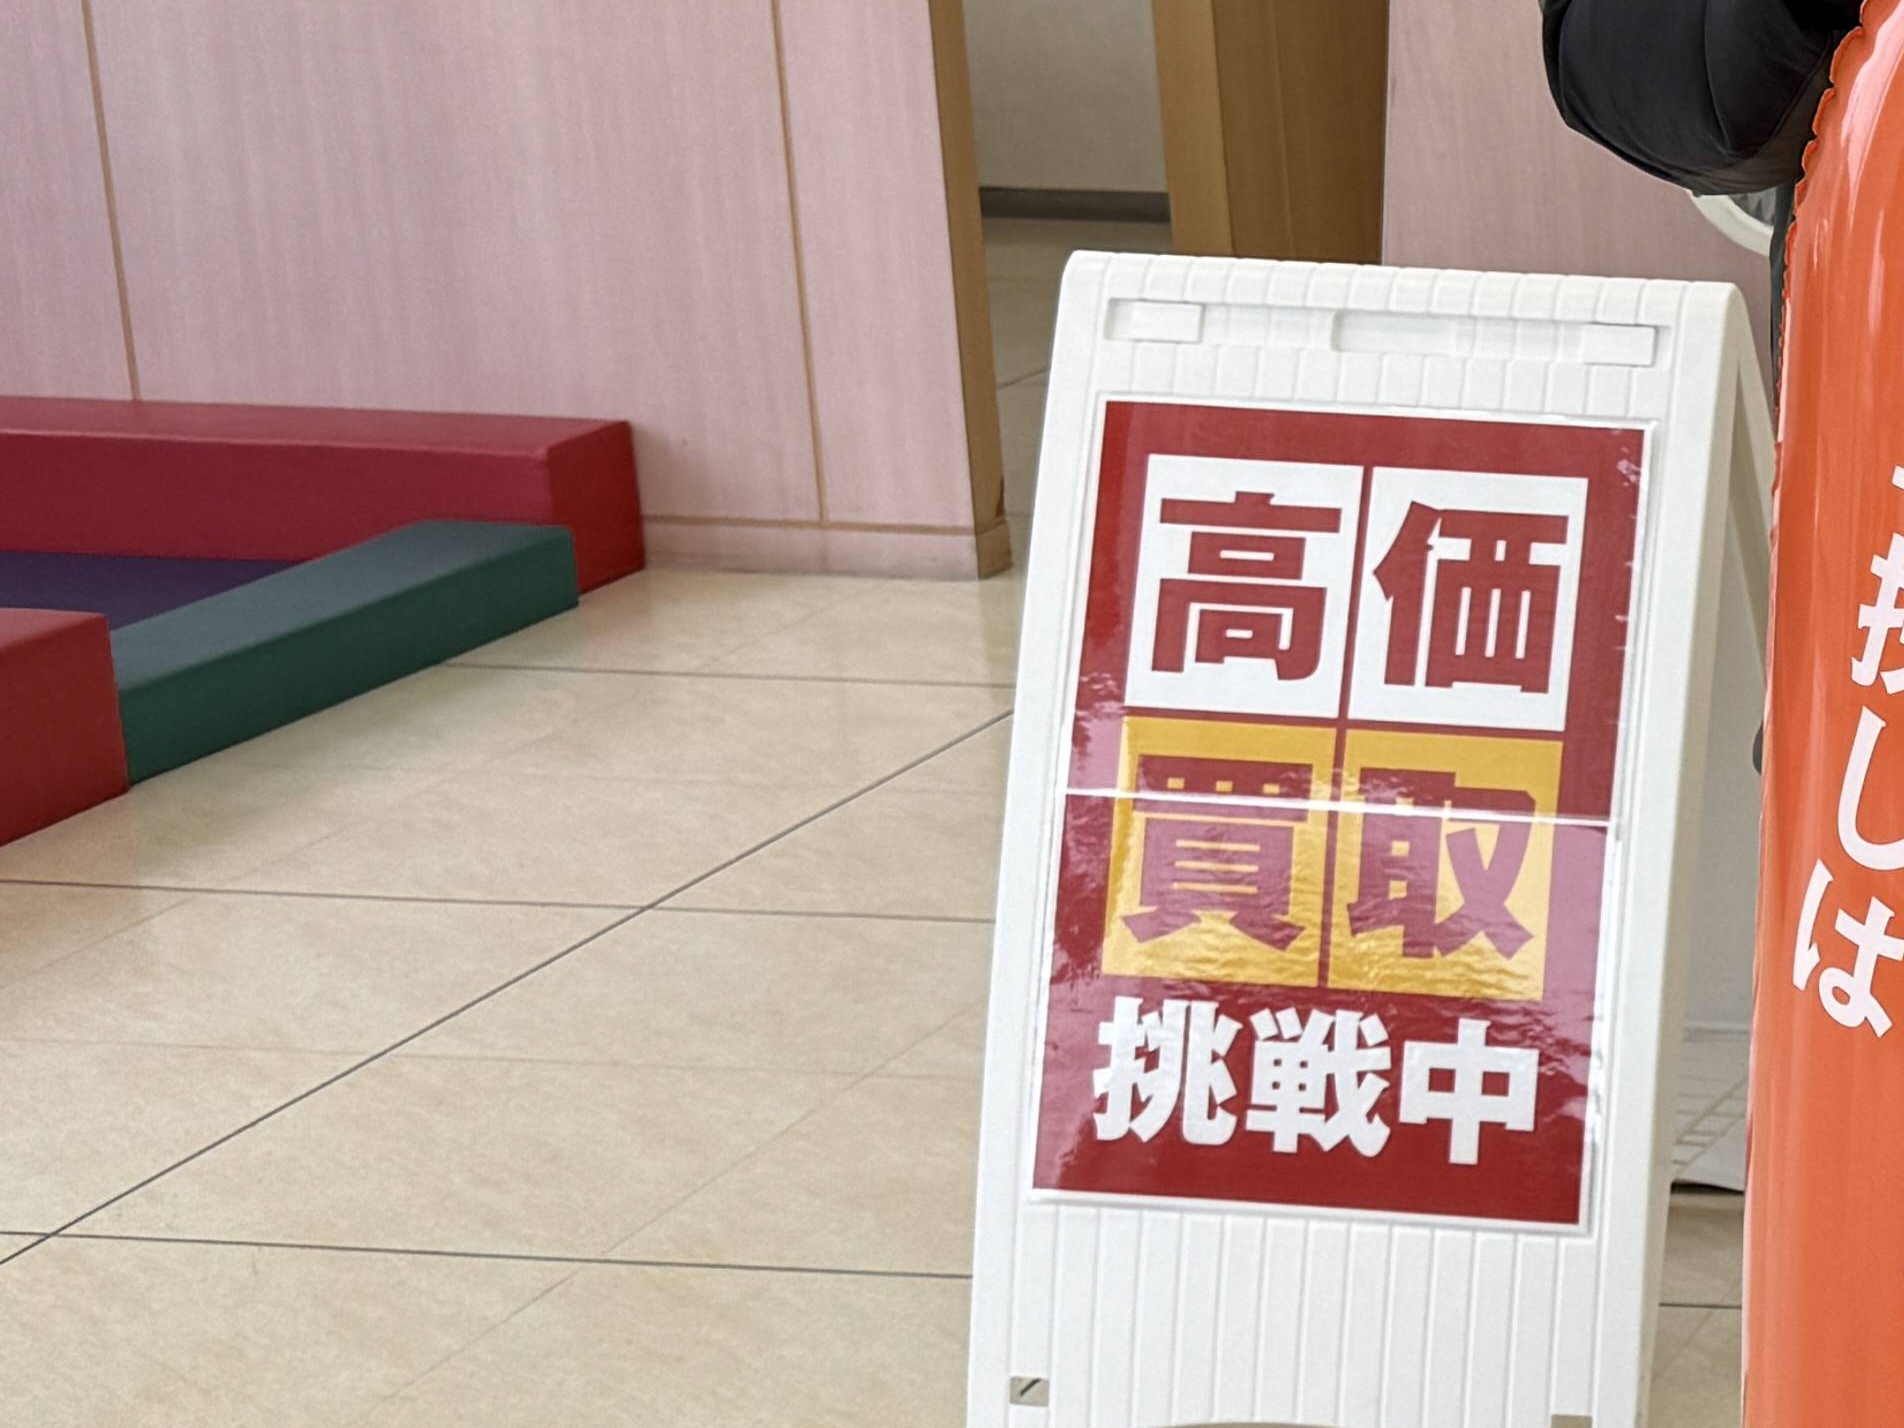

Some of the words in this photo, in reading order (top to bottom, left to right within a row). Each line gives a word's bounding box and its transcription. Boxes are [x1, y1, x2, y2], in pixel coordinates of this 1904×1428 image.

[1148, 489, 1570, 695] 高価
[1120, 755, 1538, 961] 買取
[1092, 995, 1540, 1168] 挑戦中
